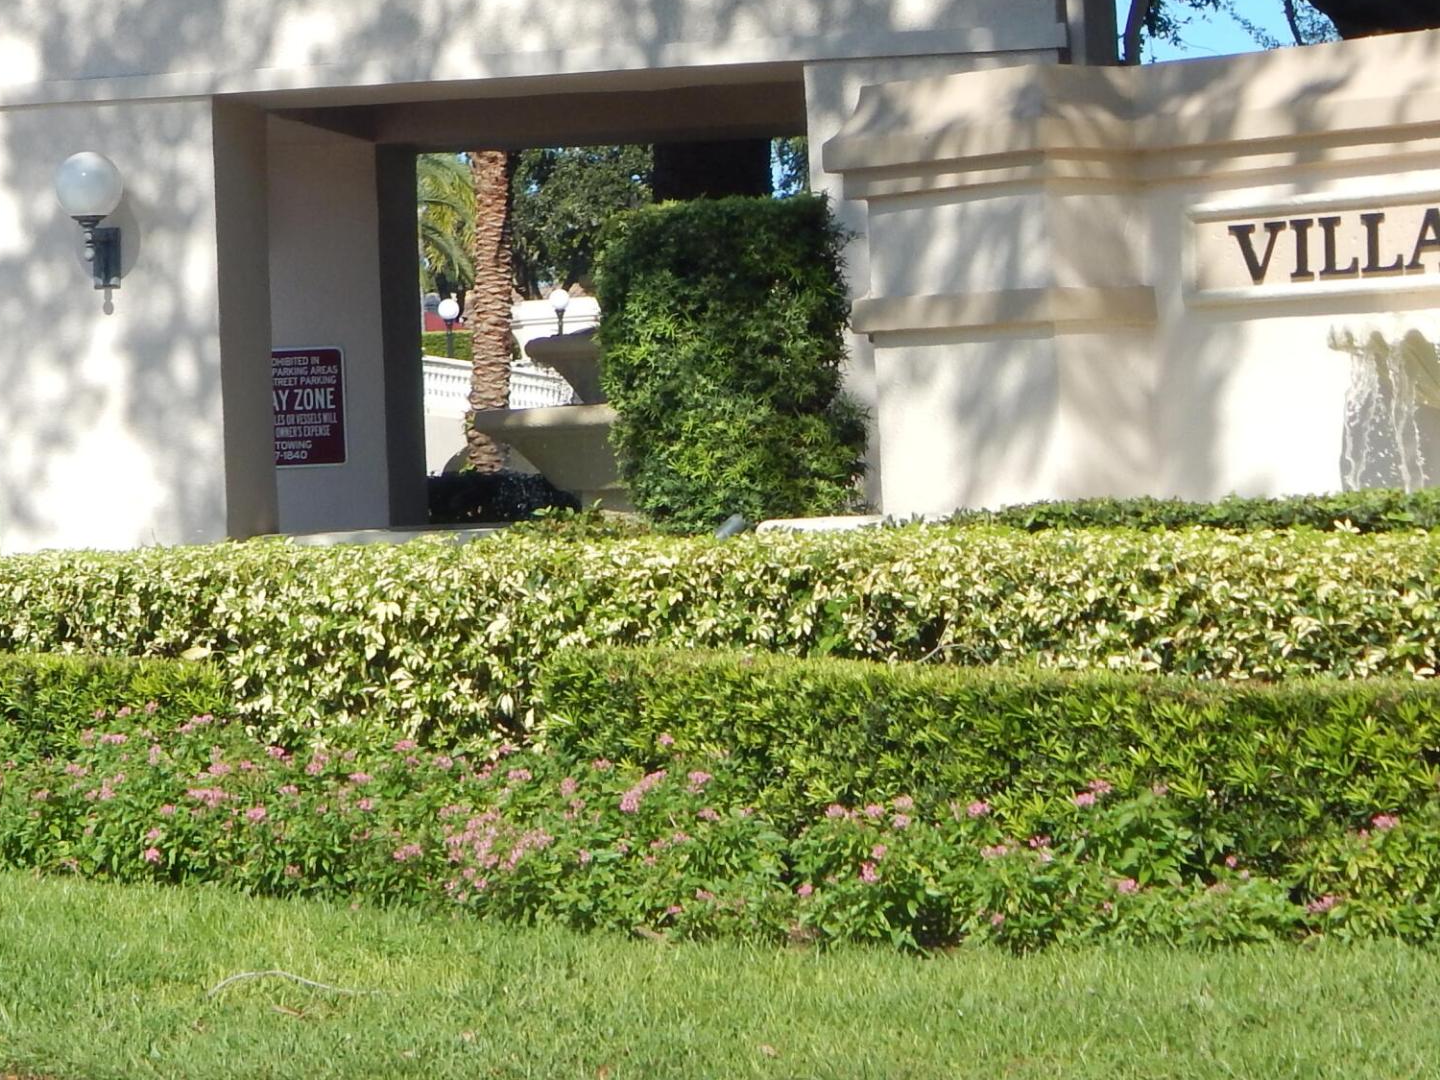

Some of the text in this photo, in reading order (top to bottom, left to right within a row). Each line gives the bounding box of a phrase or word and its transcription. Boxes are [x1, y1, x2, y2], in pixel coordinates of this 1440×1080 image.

[310, 356, 320, 365] IN
[271, 364, 338, 377] PARKING AREAS
[300, 375, 337, 385] PARKING
[294, 387, 336, 411] ZONE
[275, 440, 312, 450] TOWING
